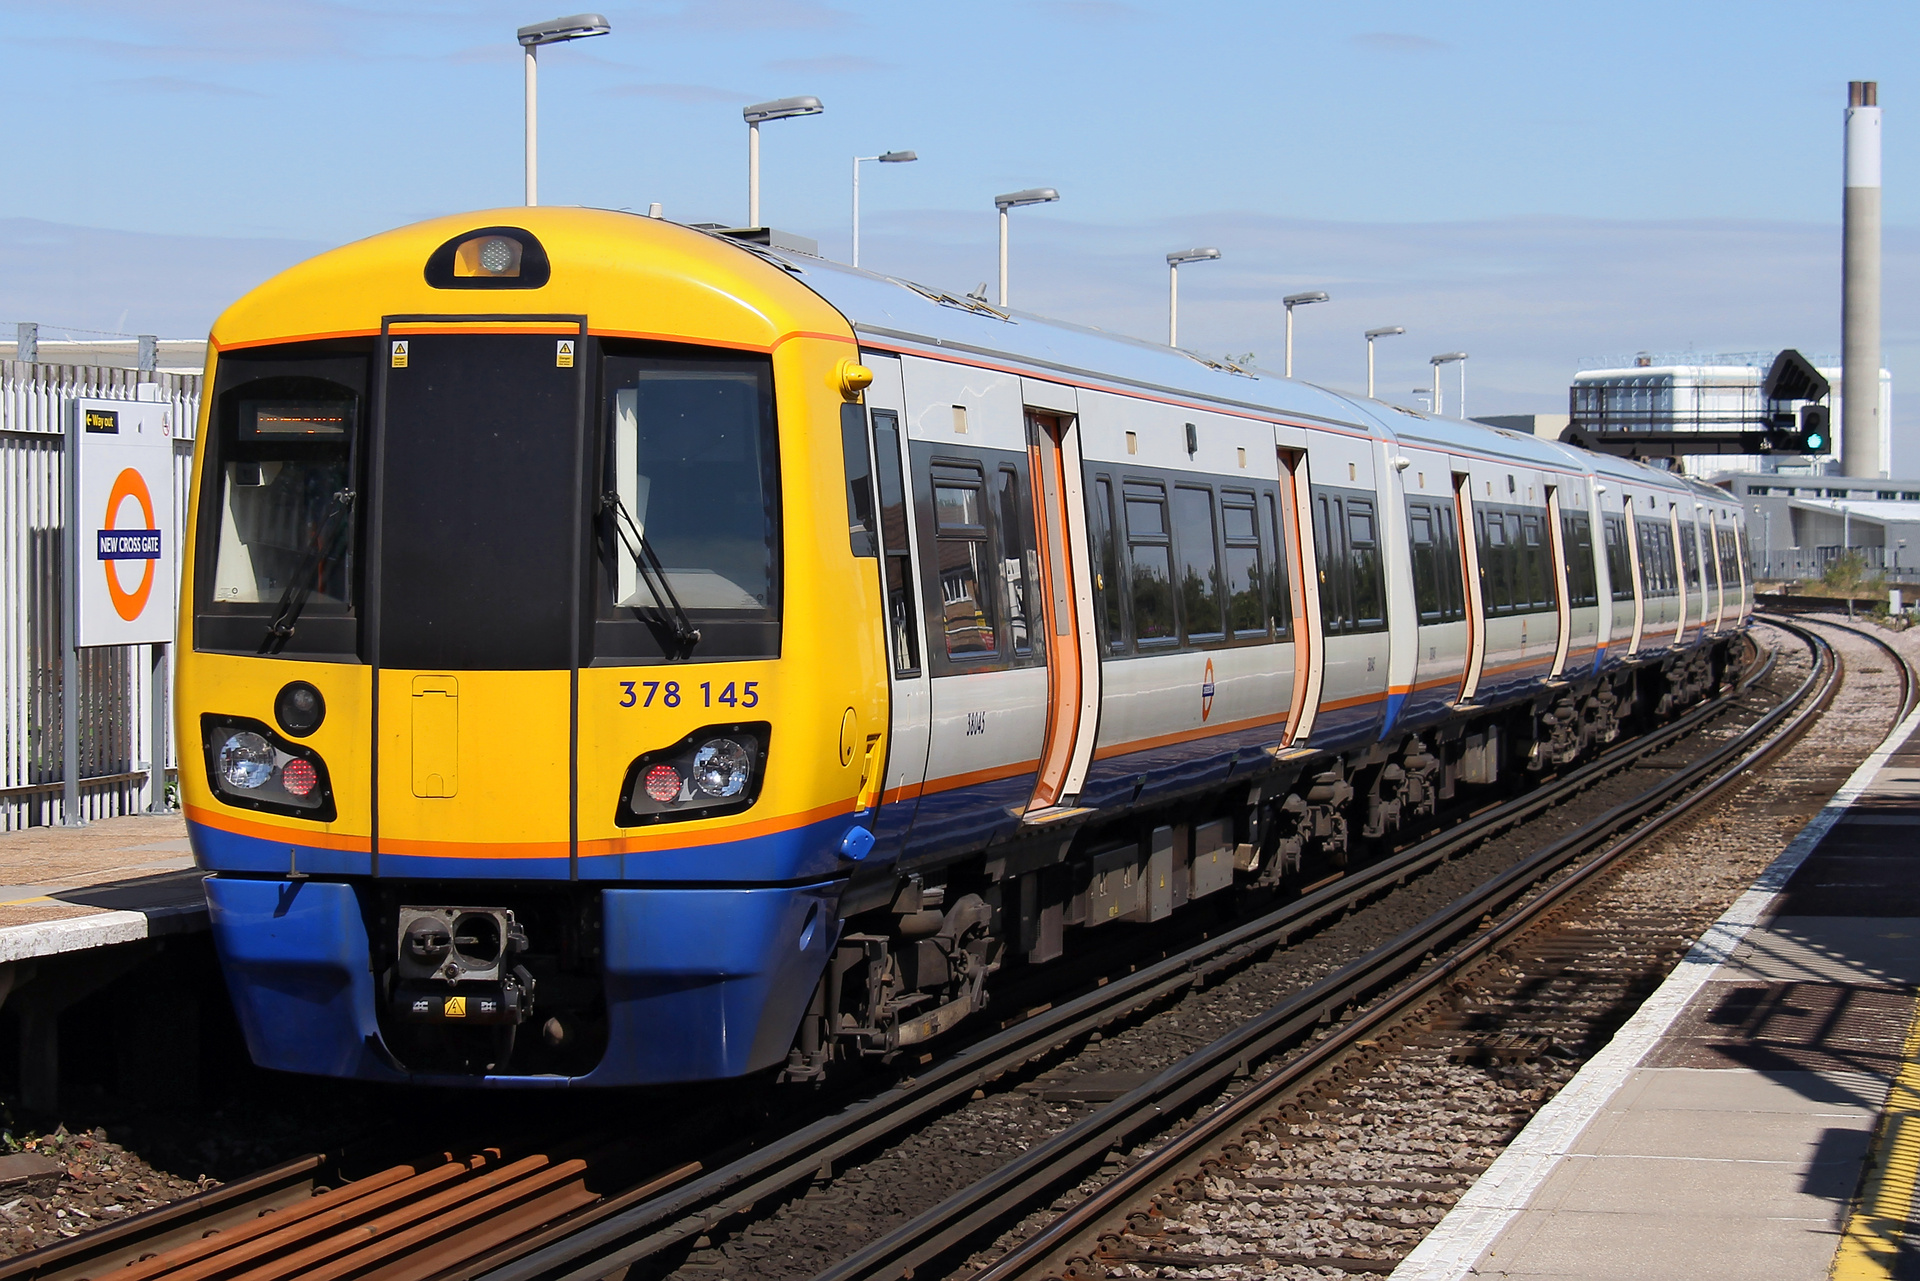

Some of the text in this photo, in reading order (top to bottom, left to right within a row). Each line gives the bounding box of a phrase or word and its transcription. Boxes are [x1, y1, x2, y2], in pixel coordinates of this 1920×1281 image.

[91, 414, 114, 429] Way out
[100, 536, 159, 553] NEW CROSS GATE
[619, 681, 759, 708] 378 145
[966, 711, 986, 736] 38045
